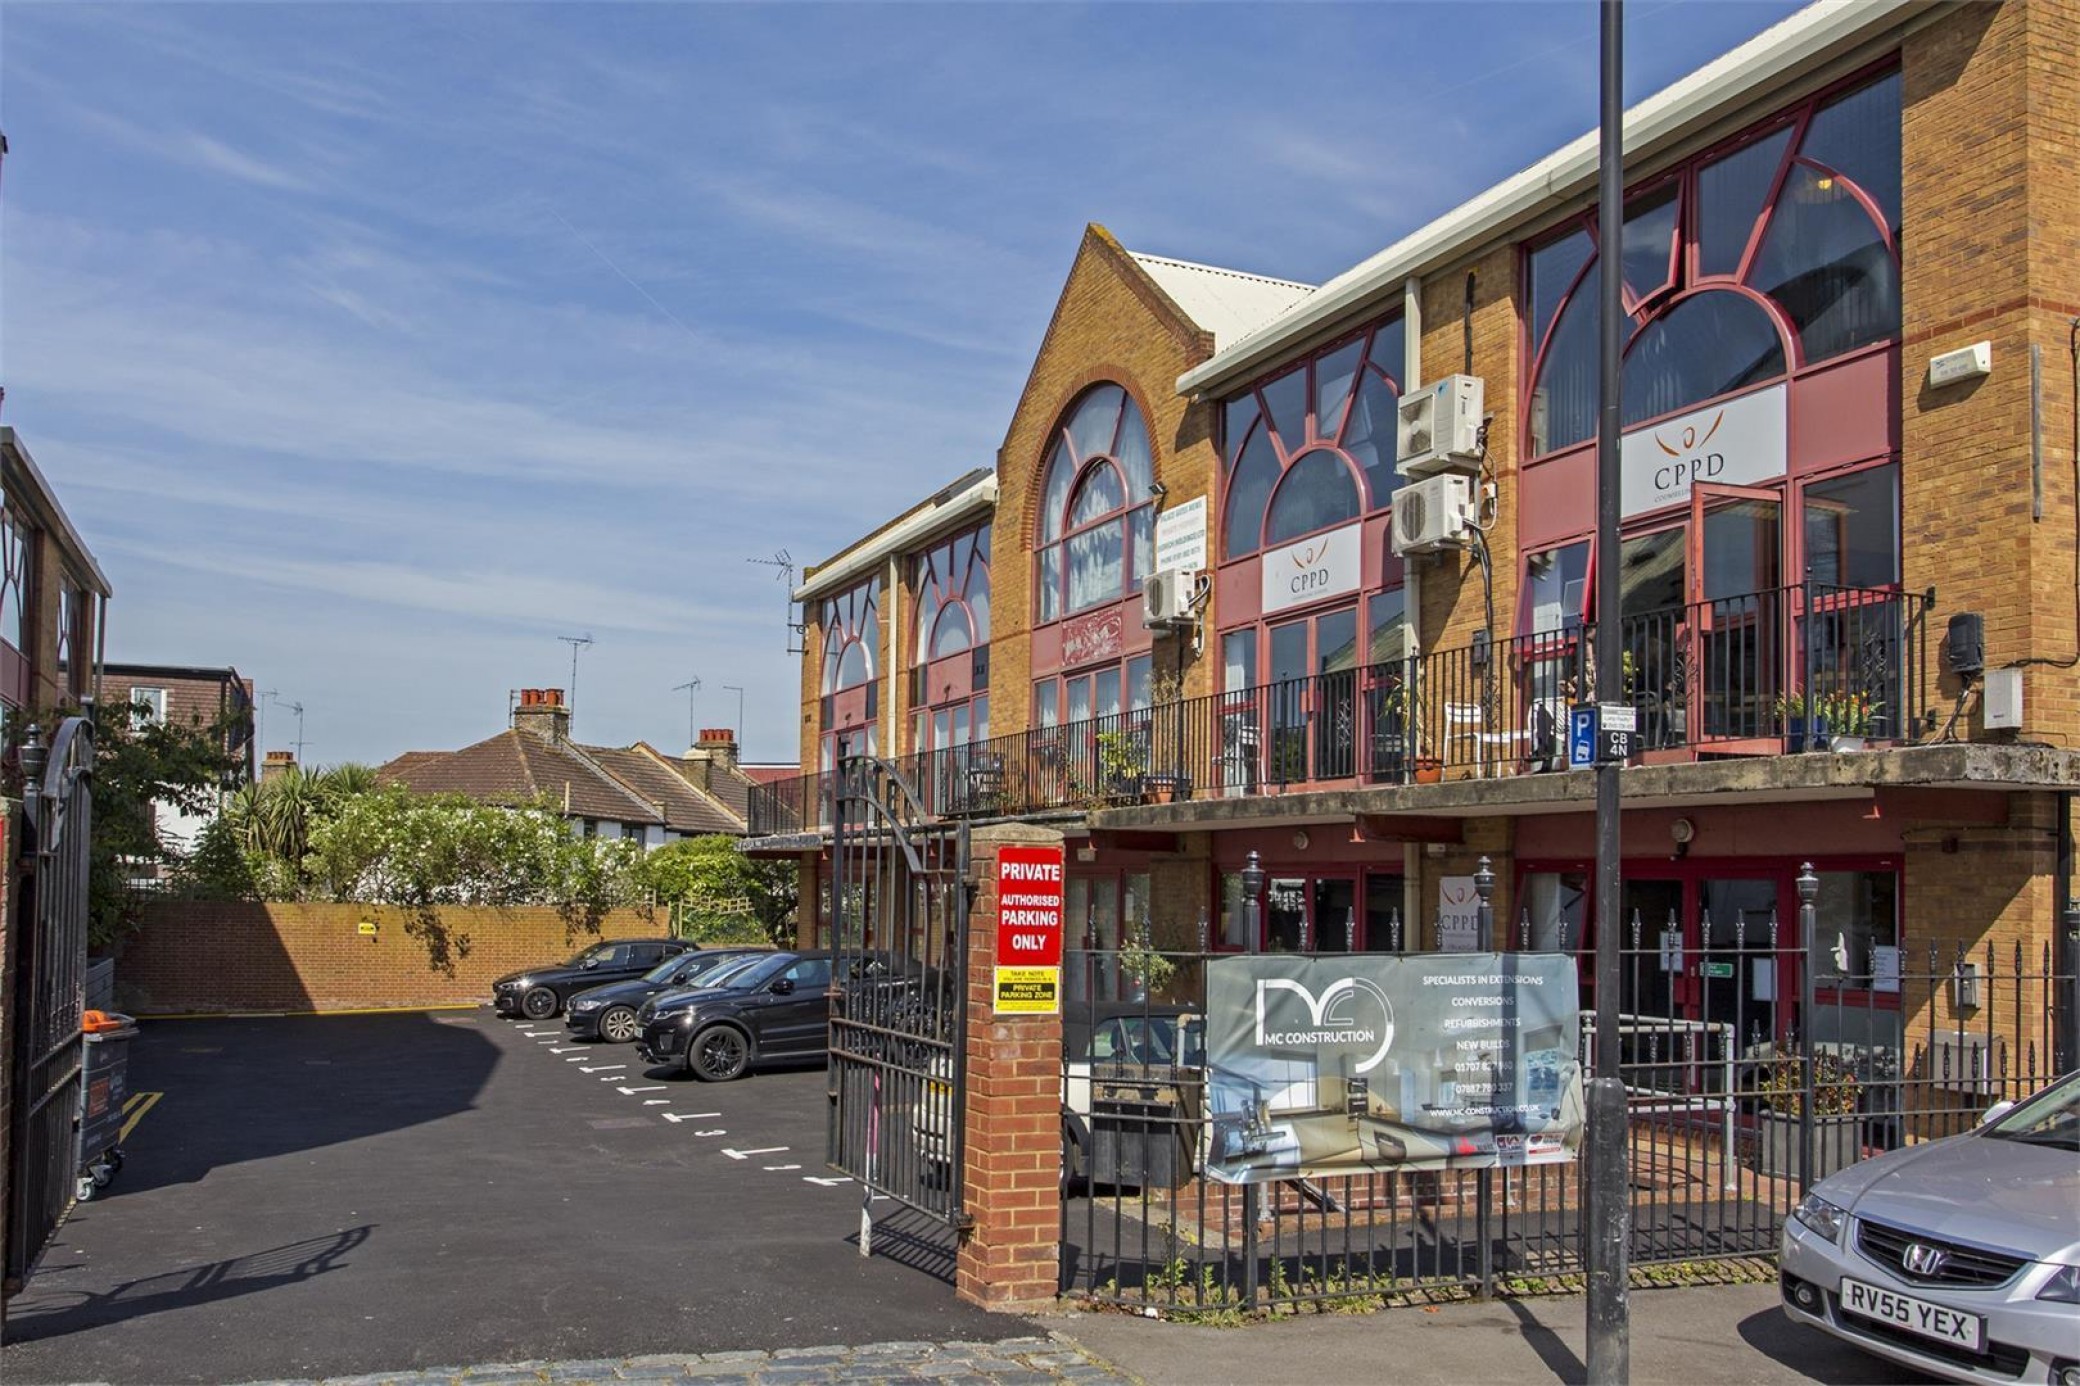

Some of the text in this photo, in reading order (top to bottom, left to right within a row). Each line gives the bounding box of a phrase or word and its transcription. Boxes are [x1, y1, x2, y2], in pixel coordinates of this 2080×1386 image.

[1654, 453, 1724, 490] CPPD
[1291, 568, 1329, 594] CPPD
[1577, 714, 1590, 737] P
[1610, 732, 1628, 744] CB
[1610, 744, 1628, 757] 4N
[1001, 863, 1060, 881] PRIVATE
[1001, 894, 1060, 907] AUTHORISED
[1002, 911, 1058, 926] PARKING
[1012, 934, 1046, 950] ONLY
[1423, 975, 1543, 986] SPECIALISTS IN EXTENSIONS
[1451, 996, 1514, 1007] CONVERSIONS
[1265, 1029, 1375, 1045] MC CONSTRUCTION
[1456, 1039, 1511, 1051] NEW BUILDS
[1851, 1285, 1967, 1341] RV55 YEX
